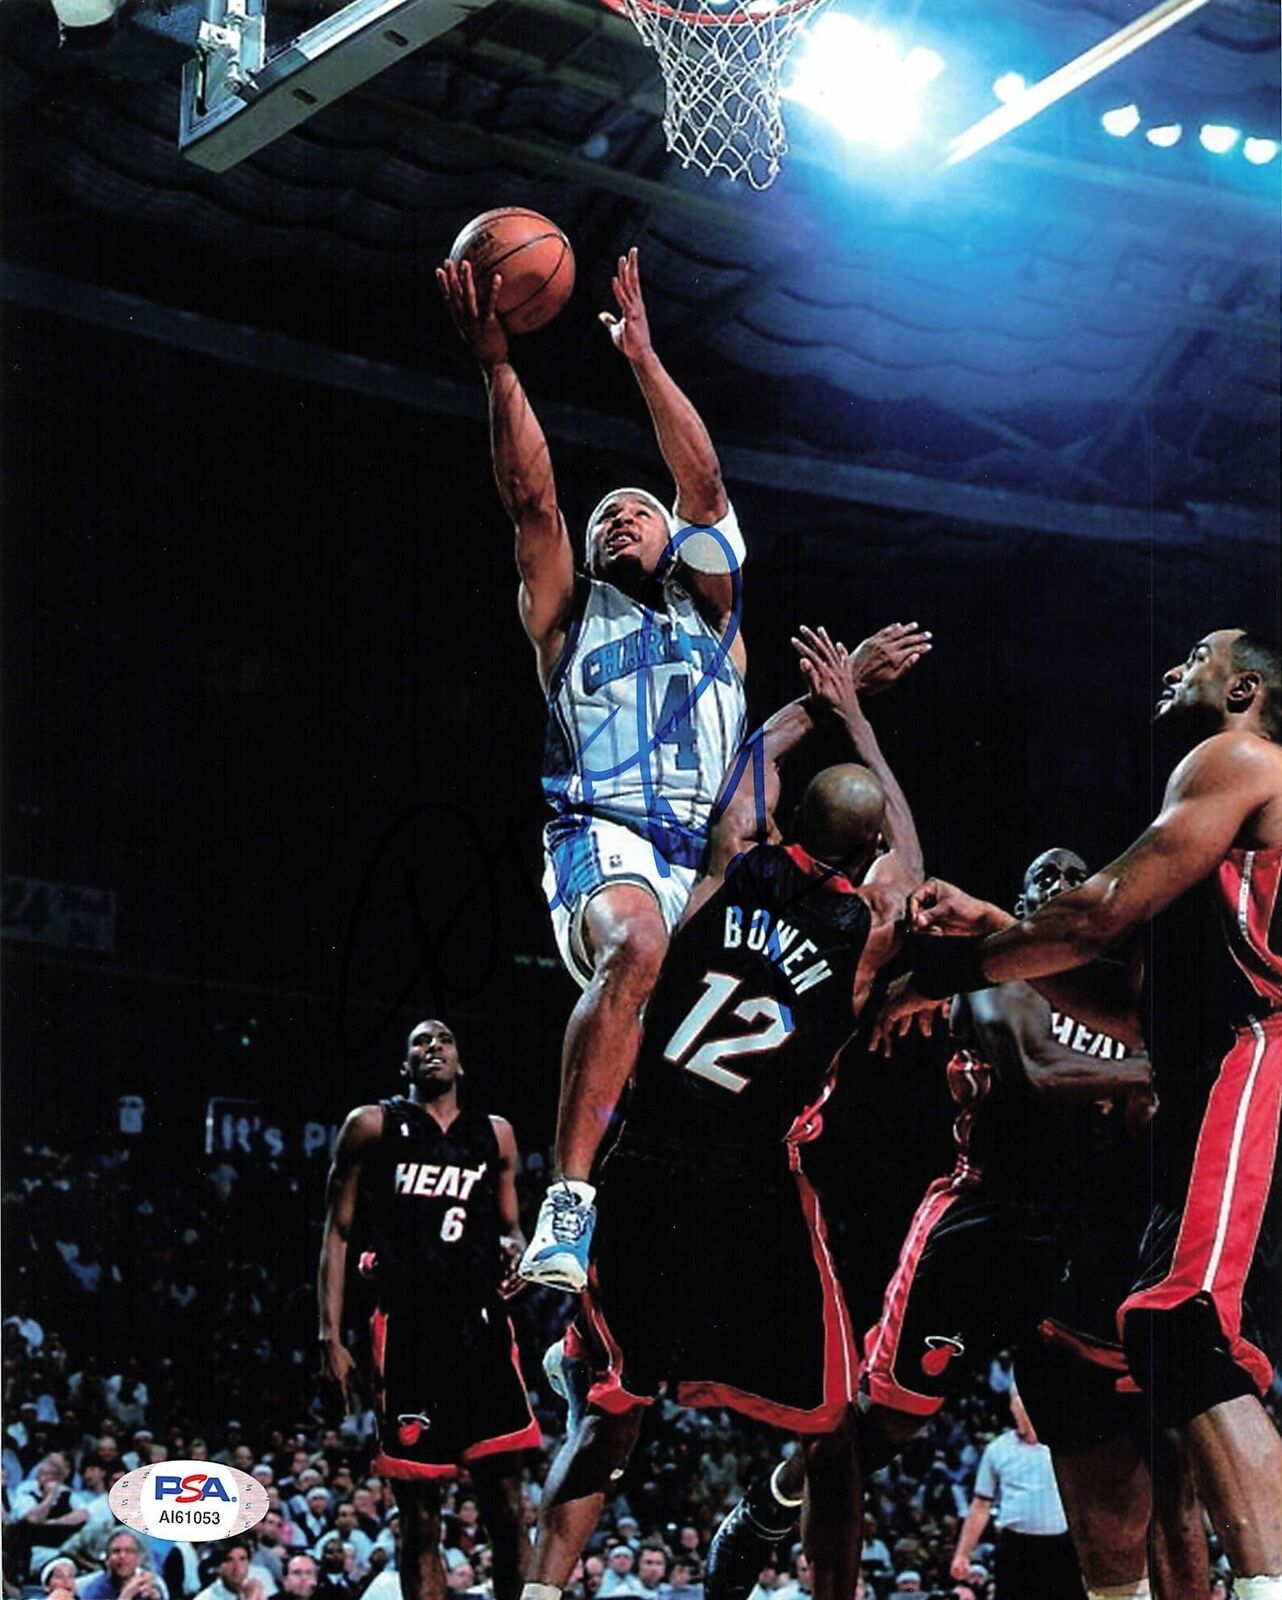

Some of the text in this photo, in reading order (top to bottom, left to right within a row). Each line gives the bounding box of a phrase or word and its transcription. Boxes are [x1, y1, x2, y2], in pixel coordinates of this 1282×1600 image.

[656, 674, 699, 771] 4
[724, 905, 833, 995] BOWEN
[663, 971, 796, 1094] 12
[395, 1161, 488, 1201] HEAT
[440, 1206, 467, 1242] 6
